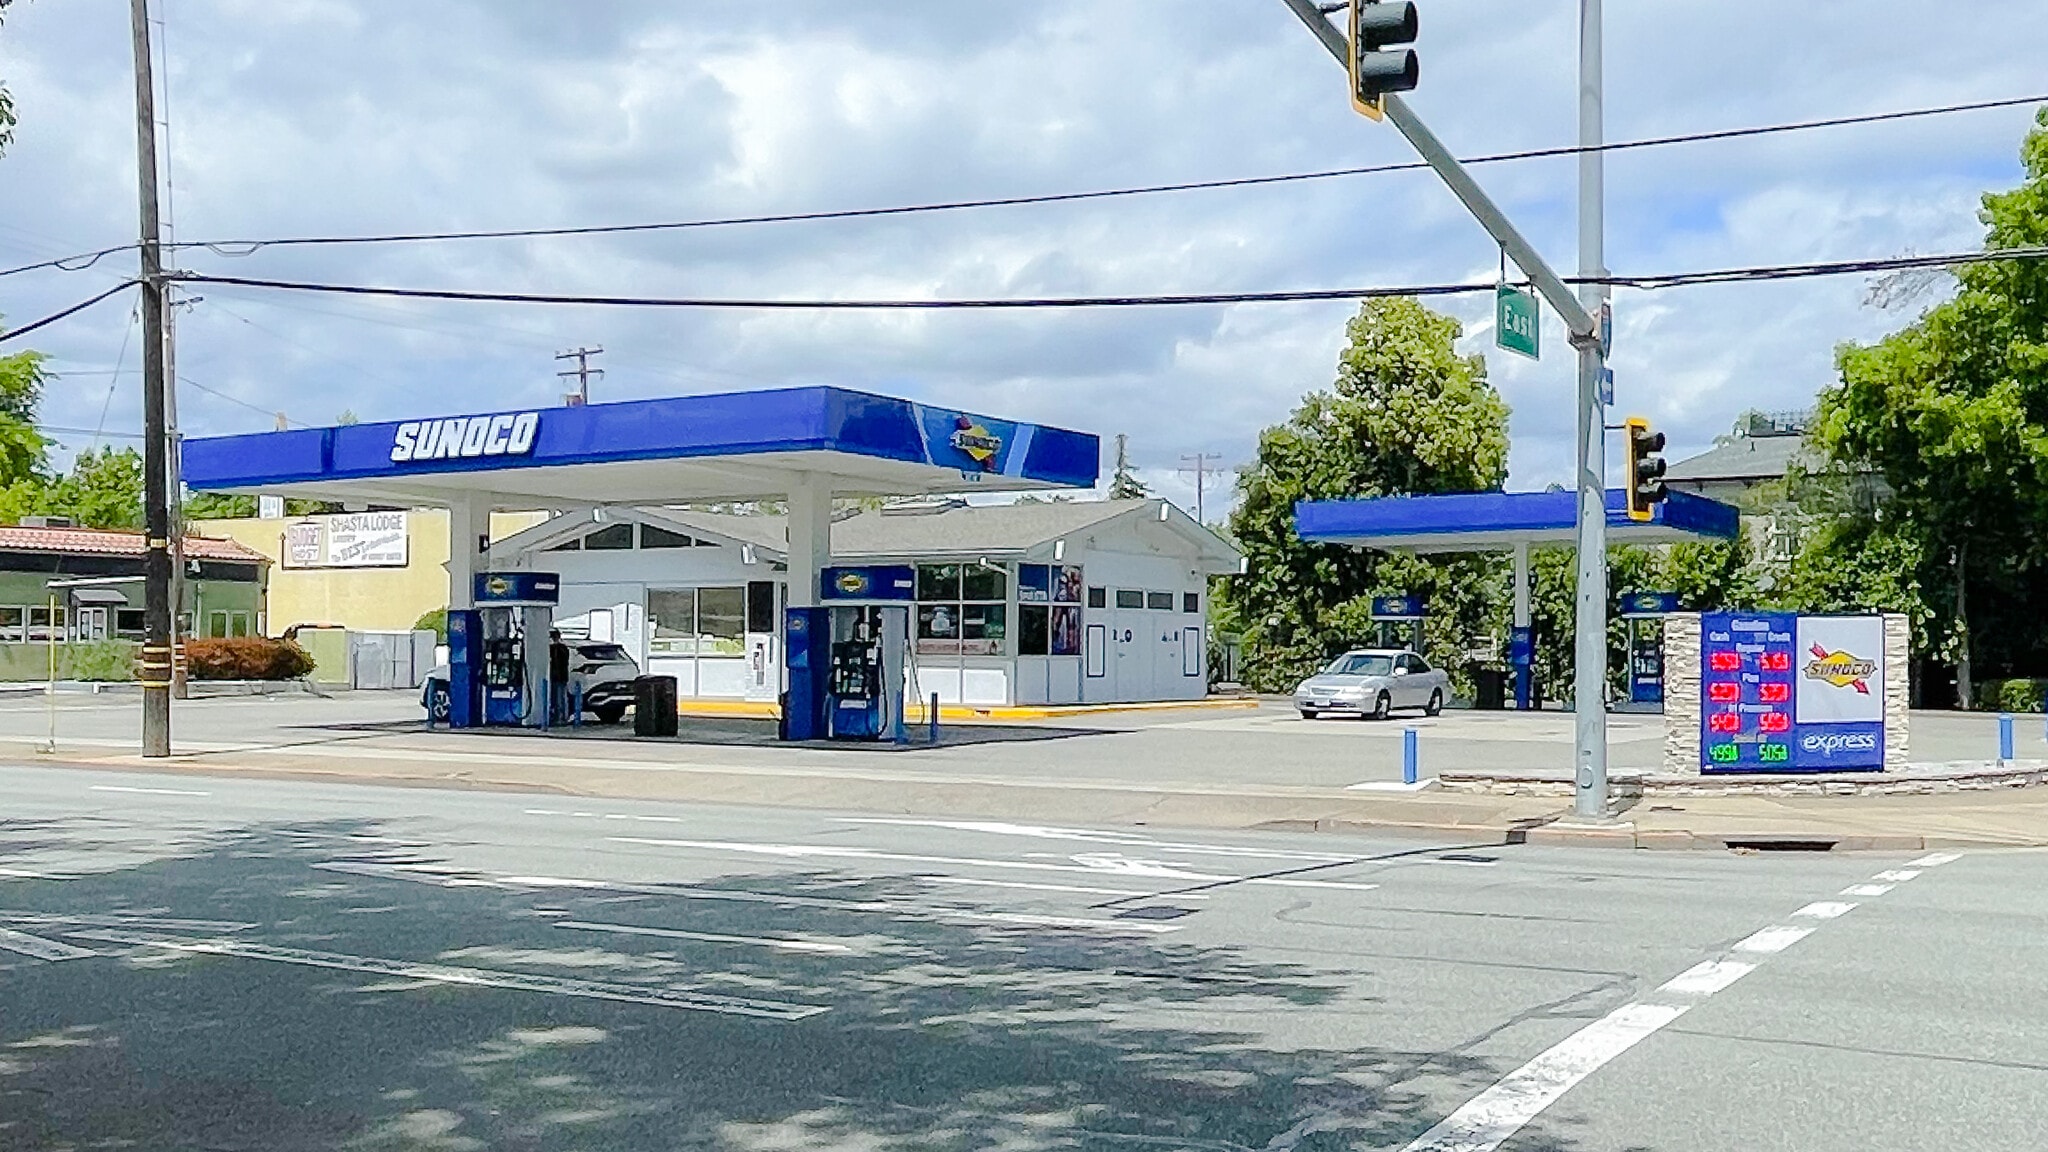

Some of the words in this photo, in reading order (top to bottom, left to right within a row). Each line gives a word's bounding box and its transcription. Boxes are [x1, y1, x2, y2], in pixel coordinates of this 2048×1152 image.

[1503, 304, 1533, 338] East
[390, 412, 539, 461] SUNOCO
[330, 515, 370, 533] SHASTA
[370, 514, 402, 531] LODGE
[1810, 663, 1872, 676] SUNOCO
[1803, 733, 1876, 756] express
